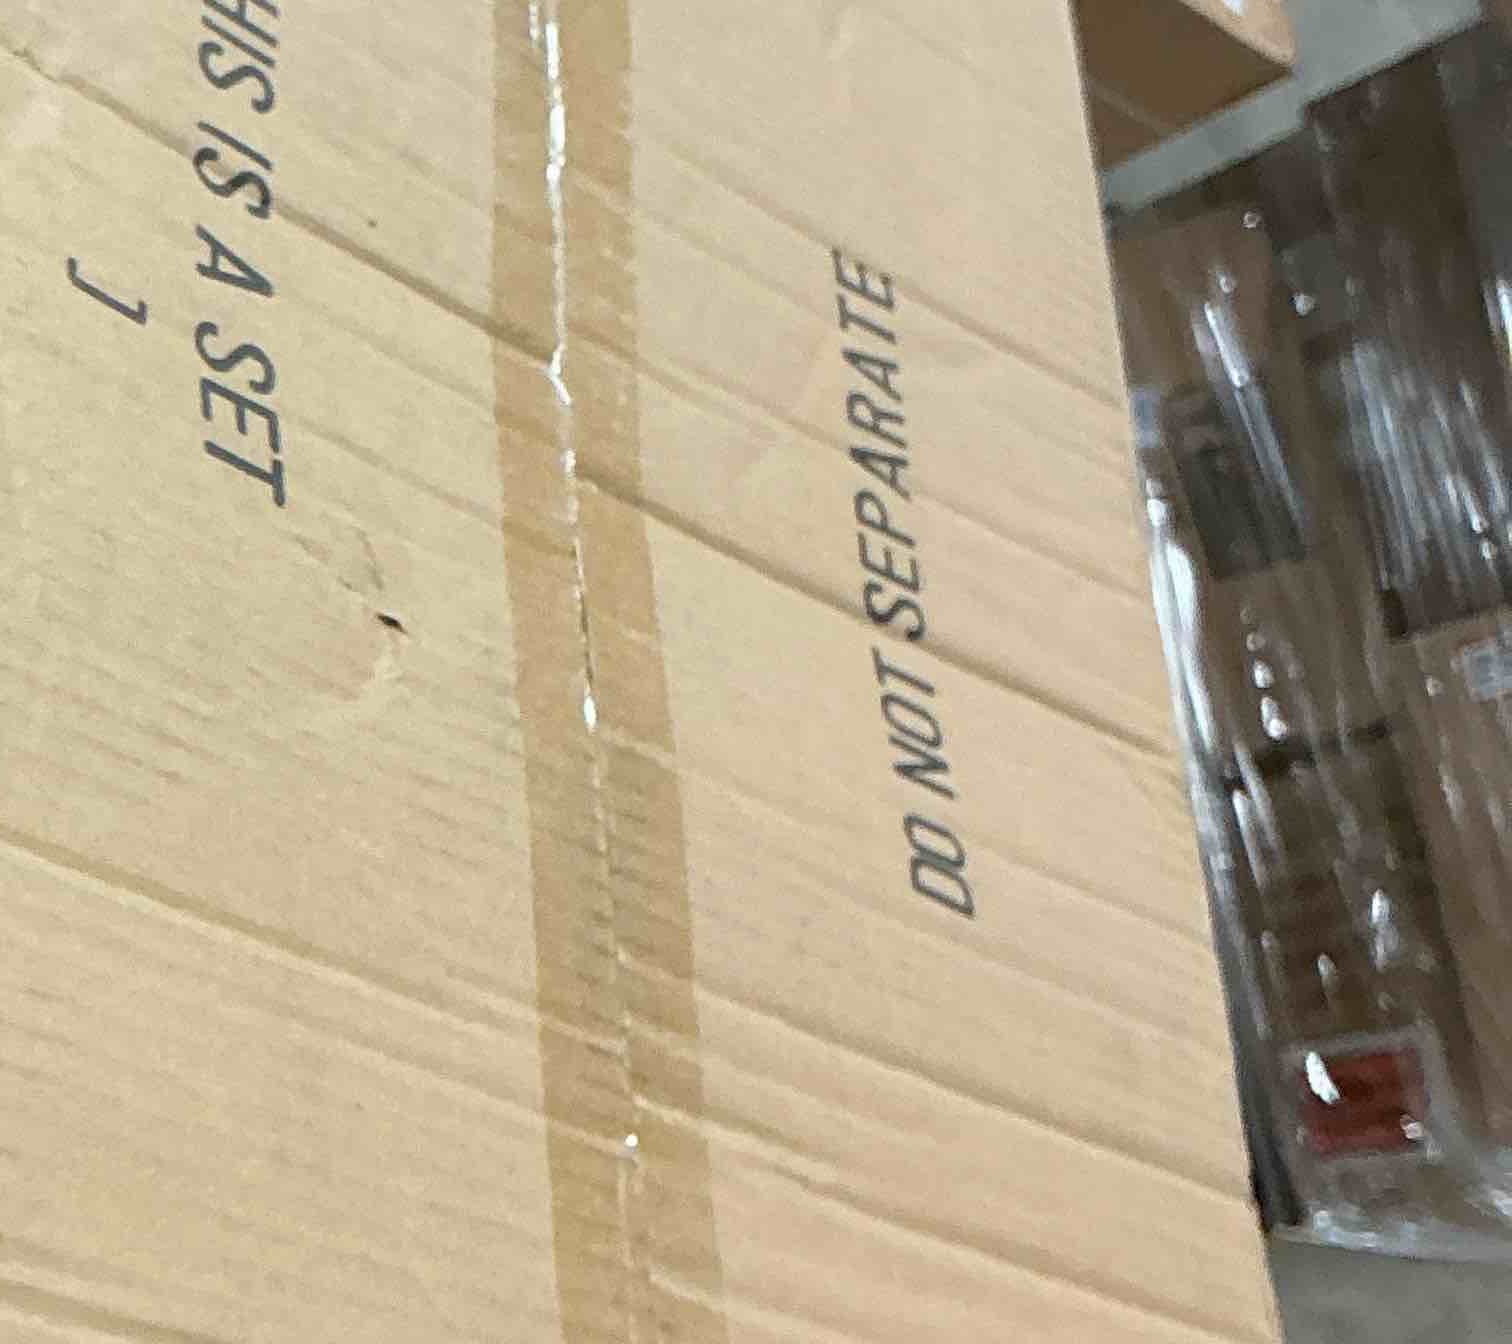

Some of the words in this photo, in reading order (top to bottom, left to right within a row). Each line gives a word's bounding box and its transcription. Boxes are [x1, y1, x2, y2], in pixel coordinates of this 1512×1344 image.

[194, 121, 274, 219] IS
[196, 225, 274, 297] A
[194, 321, 286, 508] SET
[831, 246, 928, 643] SEPARATE
[872, 645, 959, 801] NOT
[903, 812, 977, 921] DO
